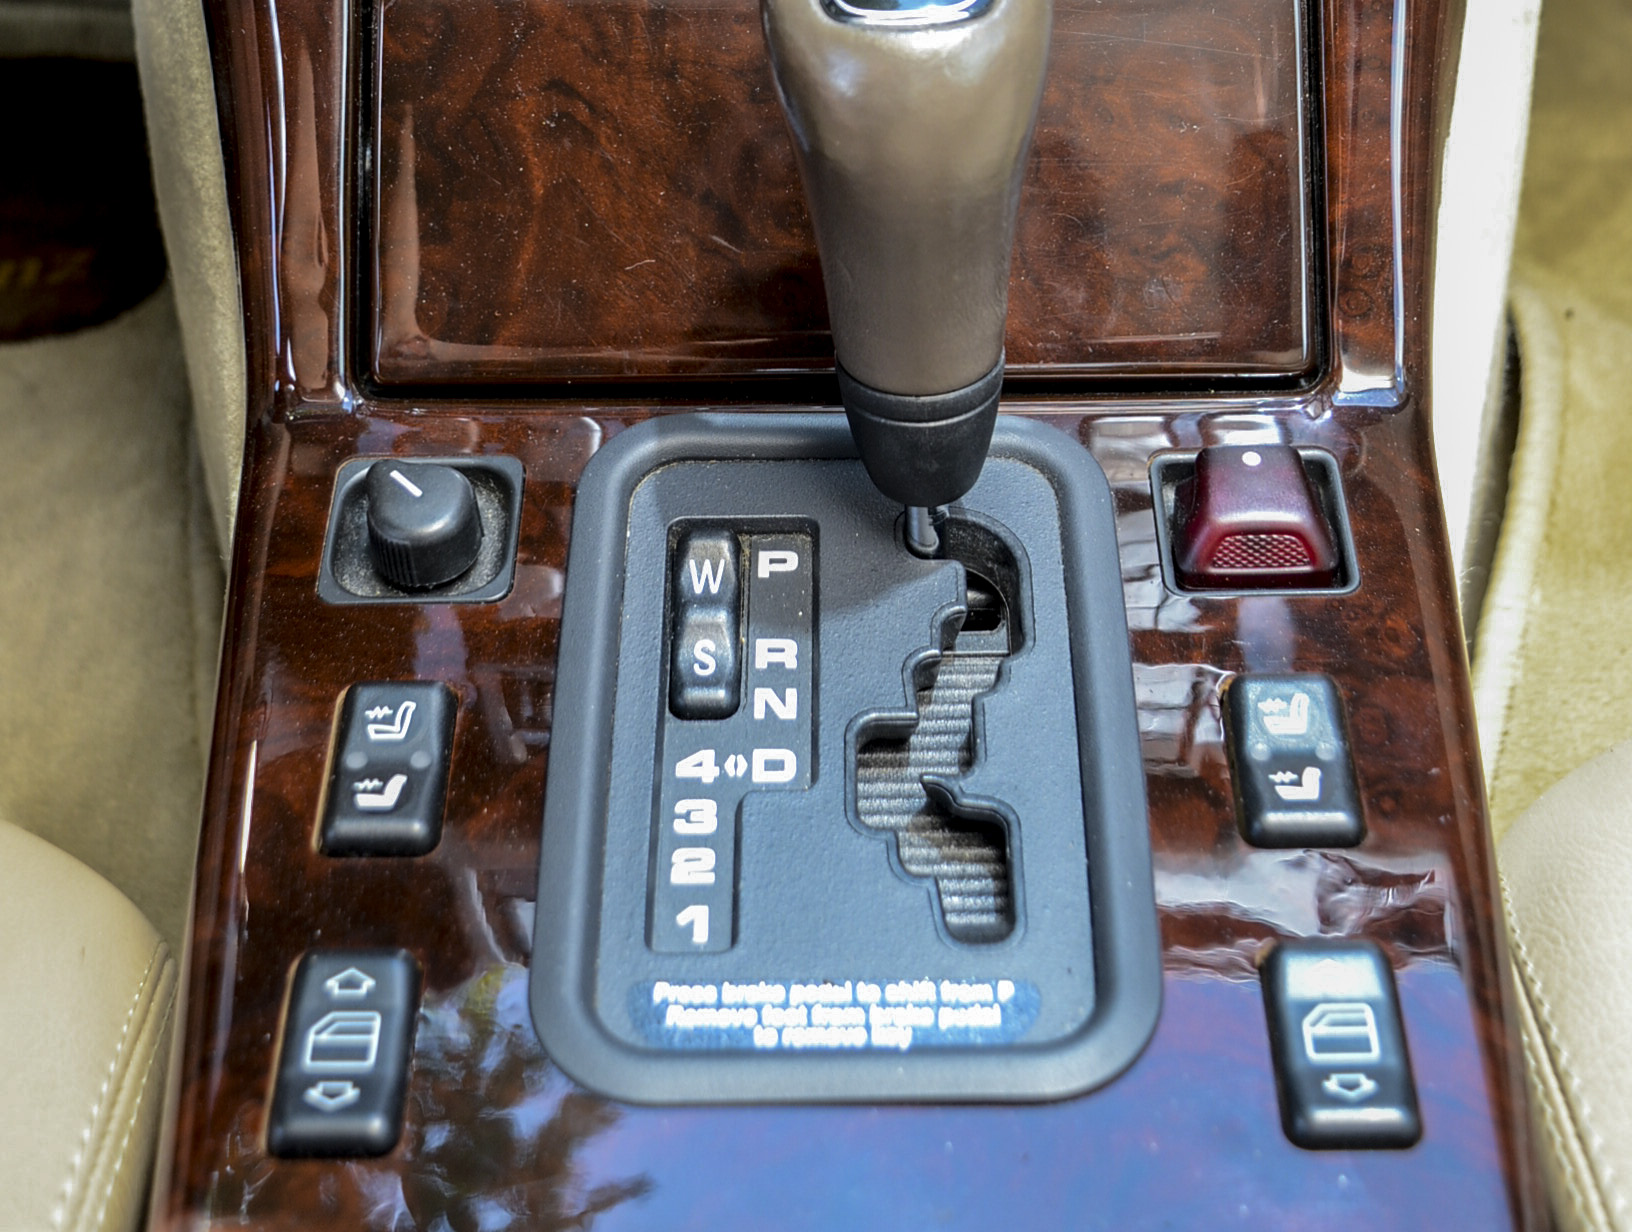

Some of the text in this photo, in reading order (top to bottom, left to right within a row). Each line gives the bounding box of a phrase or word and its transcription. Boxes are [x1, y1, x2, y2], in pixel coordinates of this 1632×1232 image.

[689, 558, 725, 595] W
[757, 550, 799, 578] P
[692, 638, 717, 677] S
[755, 638, 798, 669] R
[753, 687, 798, 720] N
[675, 748, 797, 784] 4 D
[673, 798, 718, 835] 3
[670, 847, 716, 885] 2
[675, 904, 709, 944] 1
